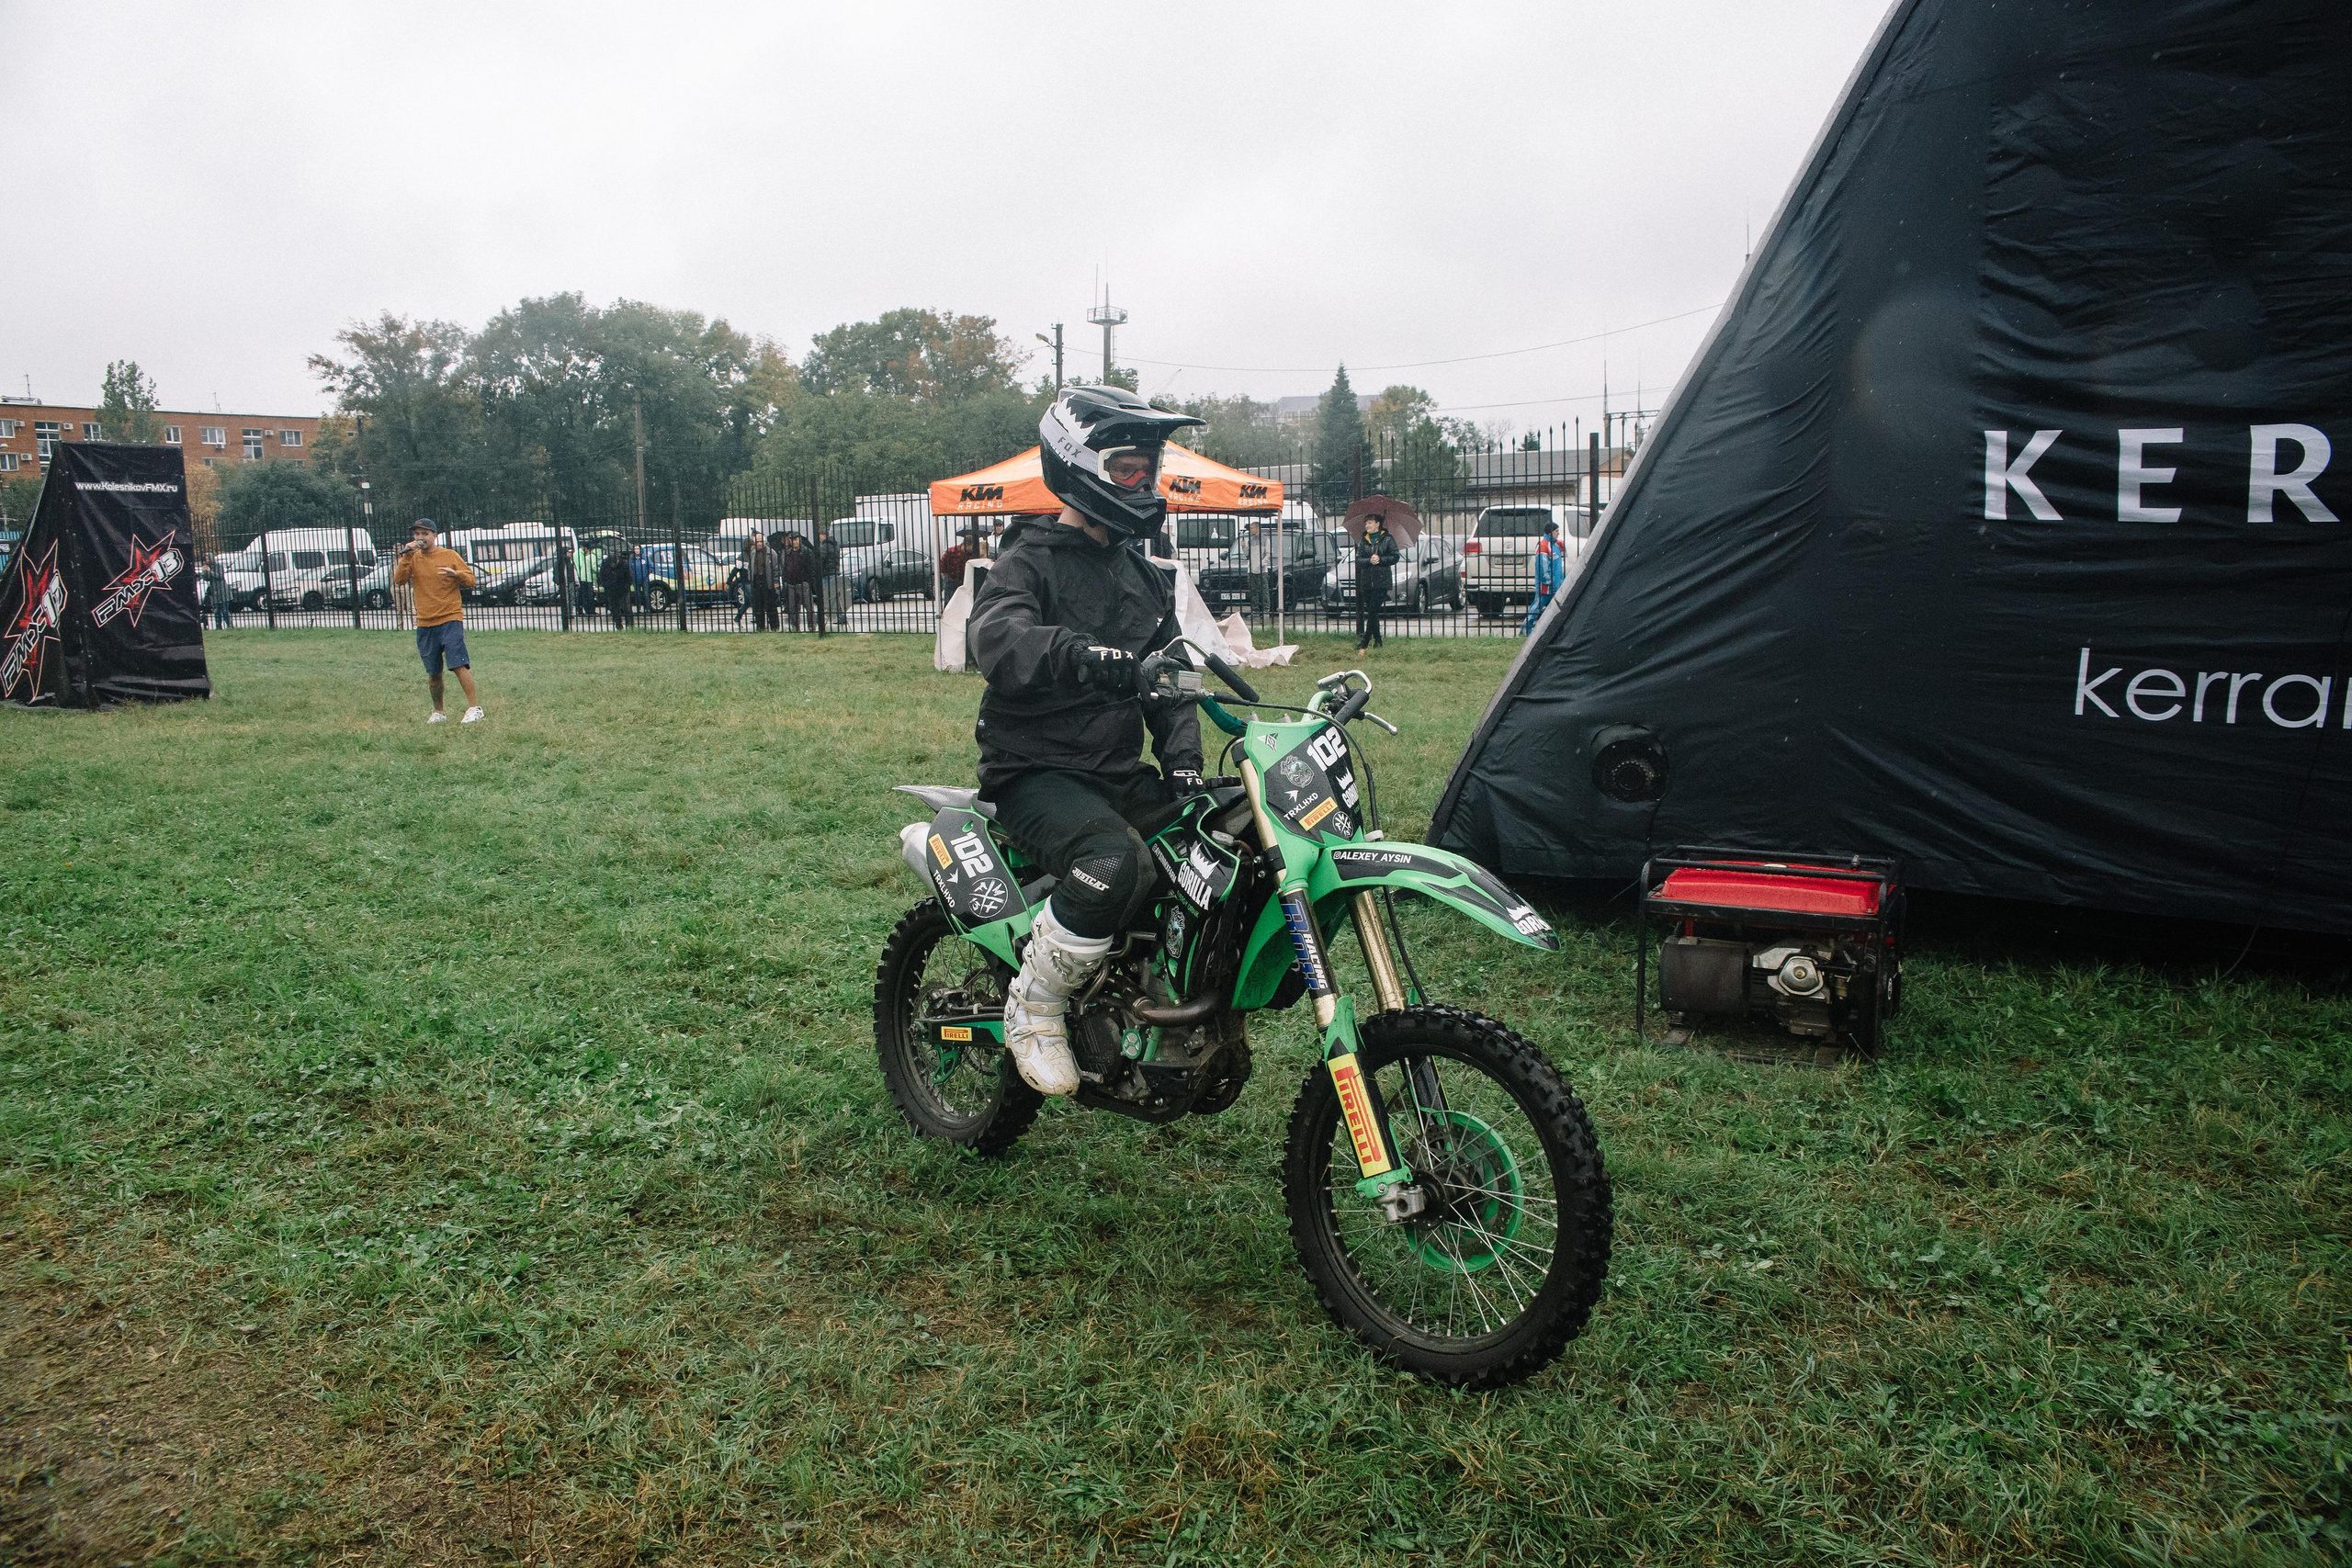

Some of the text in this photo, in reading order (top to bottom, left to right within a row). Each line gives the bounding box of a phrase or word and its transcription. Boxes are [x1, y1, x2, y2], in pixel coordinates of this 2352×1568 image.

[1057, 436, 1082, 458] FOX
[1169, 475, 1202, 494] KTM
[1984, 423, 2341, 524] KER
[960, 483, 1004, 502] KTM
[1239, 482, 1268, 499] KTM
[957, 500, 1003, 511] RACING
[1100, 649, 1135, 661] FOX
[1306, 726, 1348, 772] 102
[1186, 777, 1204, 786] FO
[1283, 792, 1319, 821] TRXLHXD
[1303, 799, 1335, 828] PIRELLI
[931, 837, 951, 865] PIRELLI
[950, 831, 994, 879] 102
[932, 868, 956, 908] TRXLHXD
[1177, 861, 1213, 911] GORILLA
[1303, 933, 1329, 989] RACING
[944, 1028, 969, 1039] PIRELLI
[1334, 1066, 1382, 1165] PIRELLI
